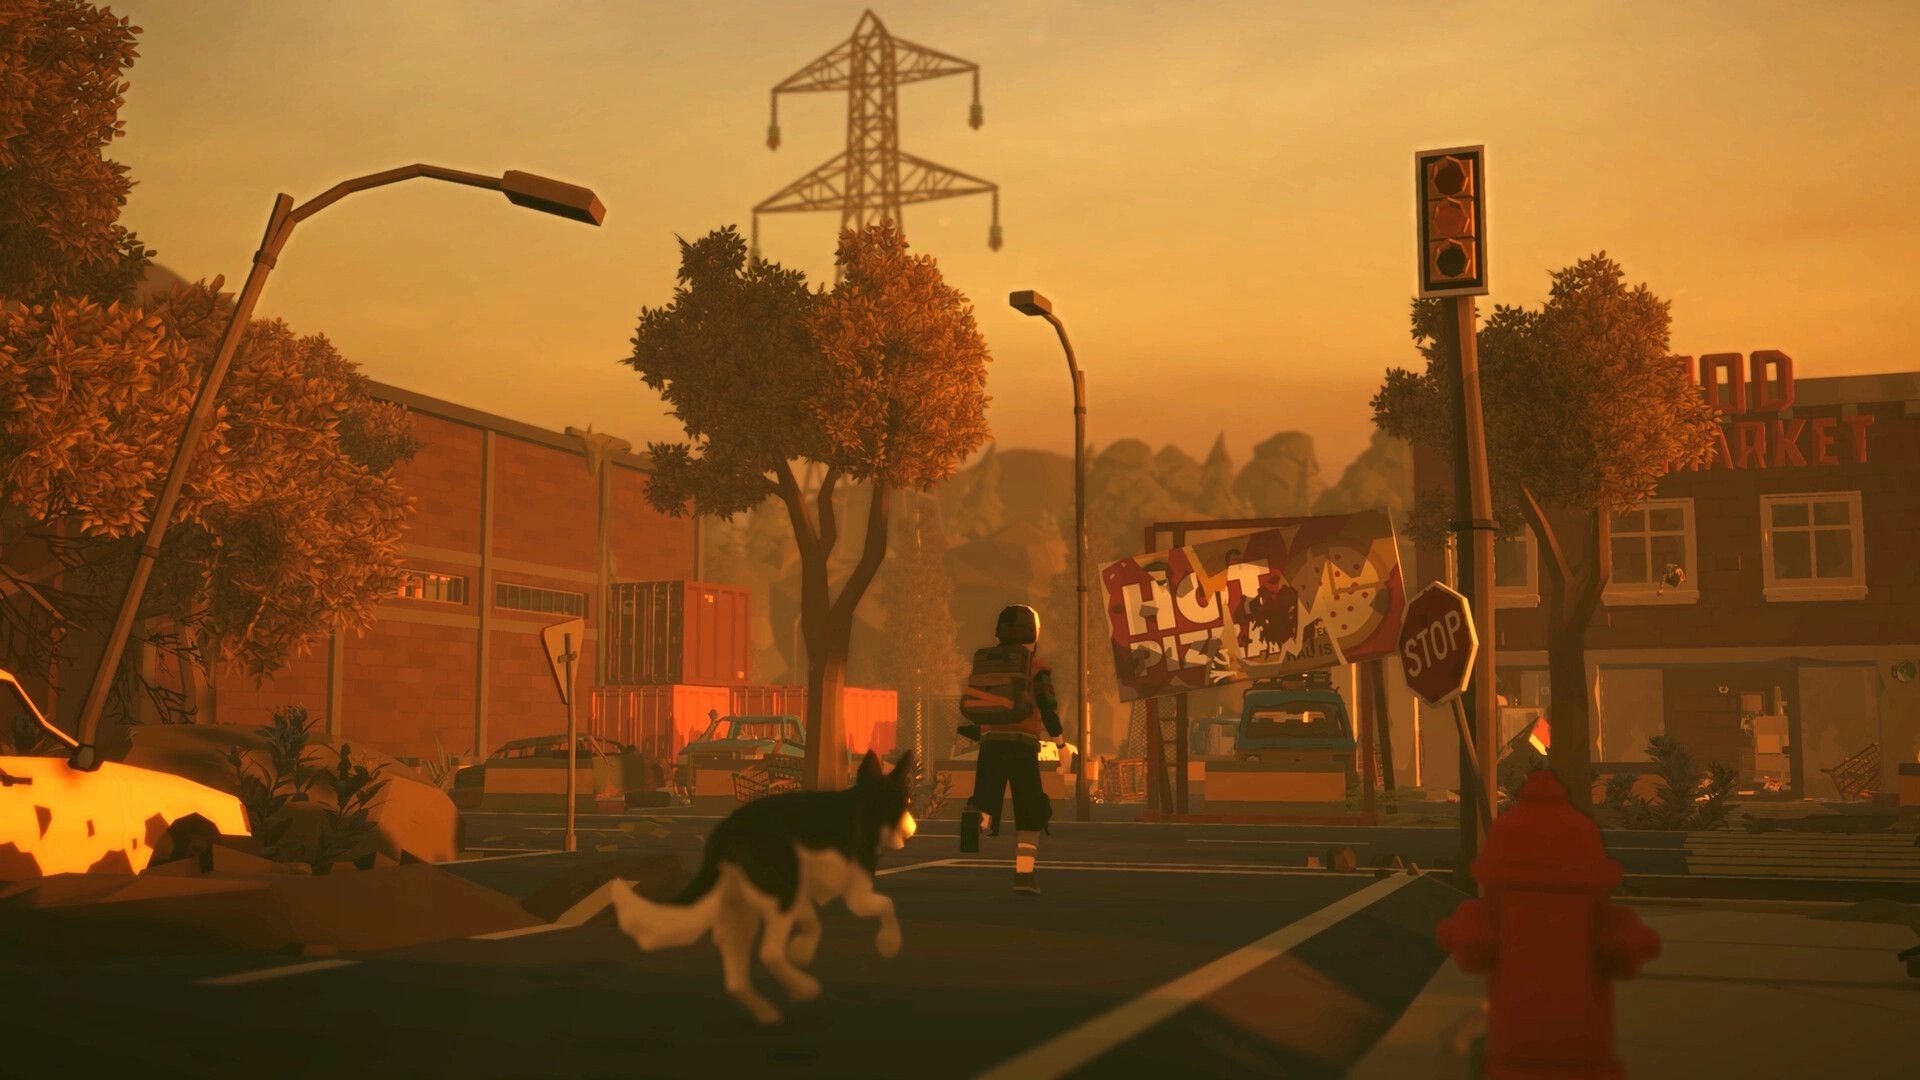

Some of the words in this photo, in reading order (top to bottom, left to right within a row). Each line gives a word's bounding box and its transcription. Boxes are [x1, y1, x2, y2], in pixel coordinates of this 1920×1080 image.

[1677, 350, 1794, 415] OD
[1664, 415, 1874, 473] ARKET
[1405, 610, 1461, 677] STOP
